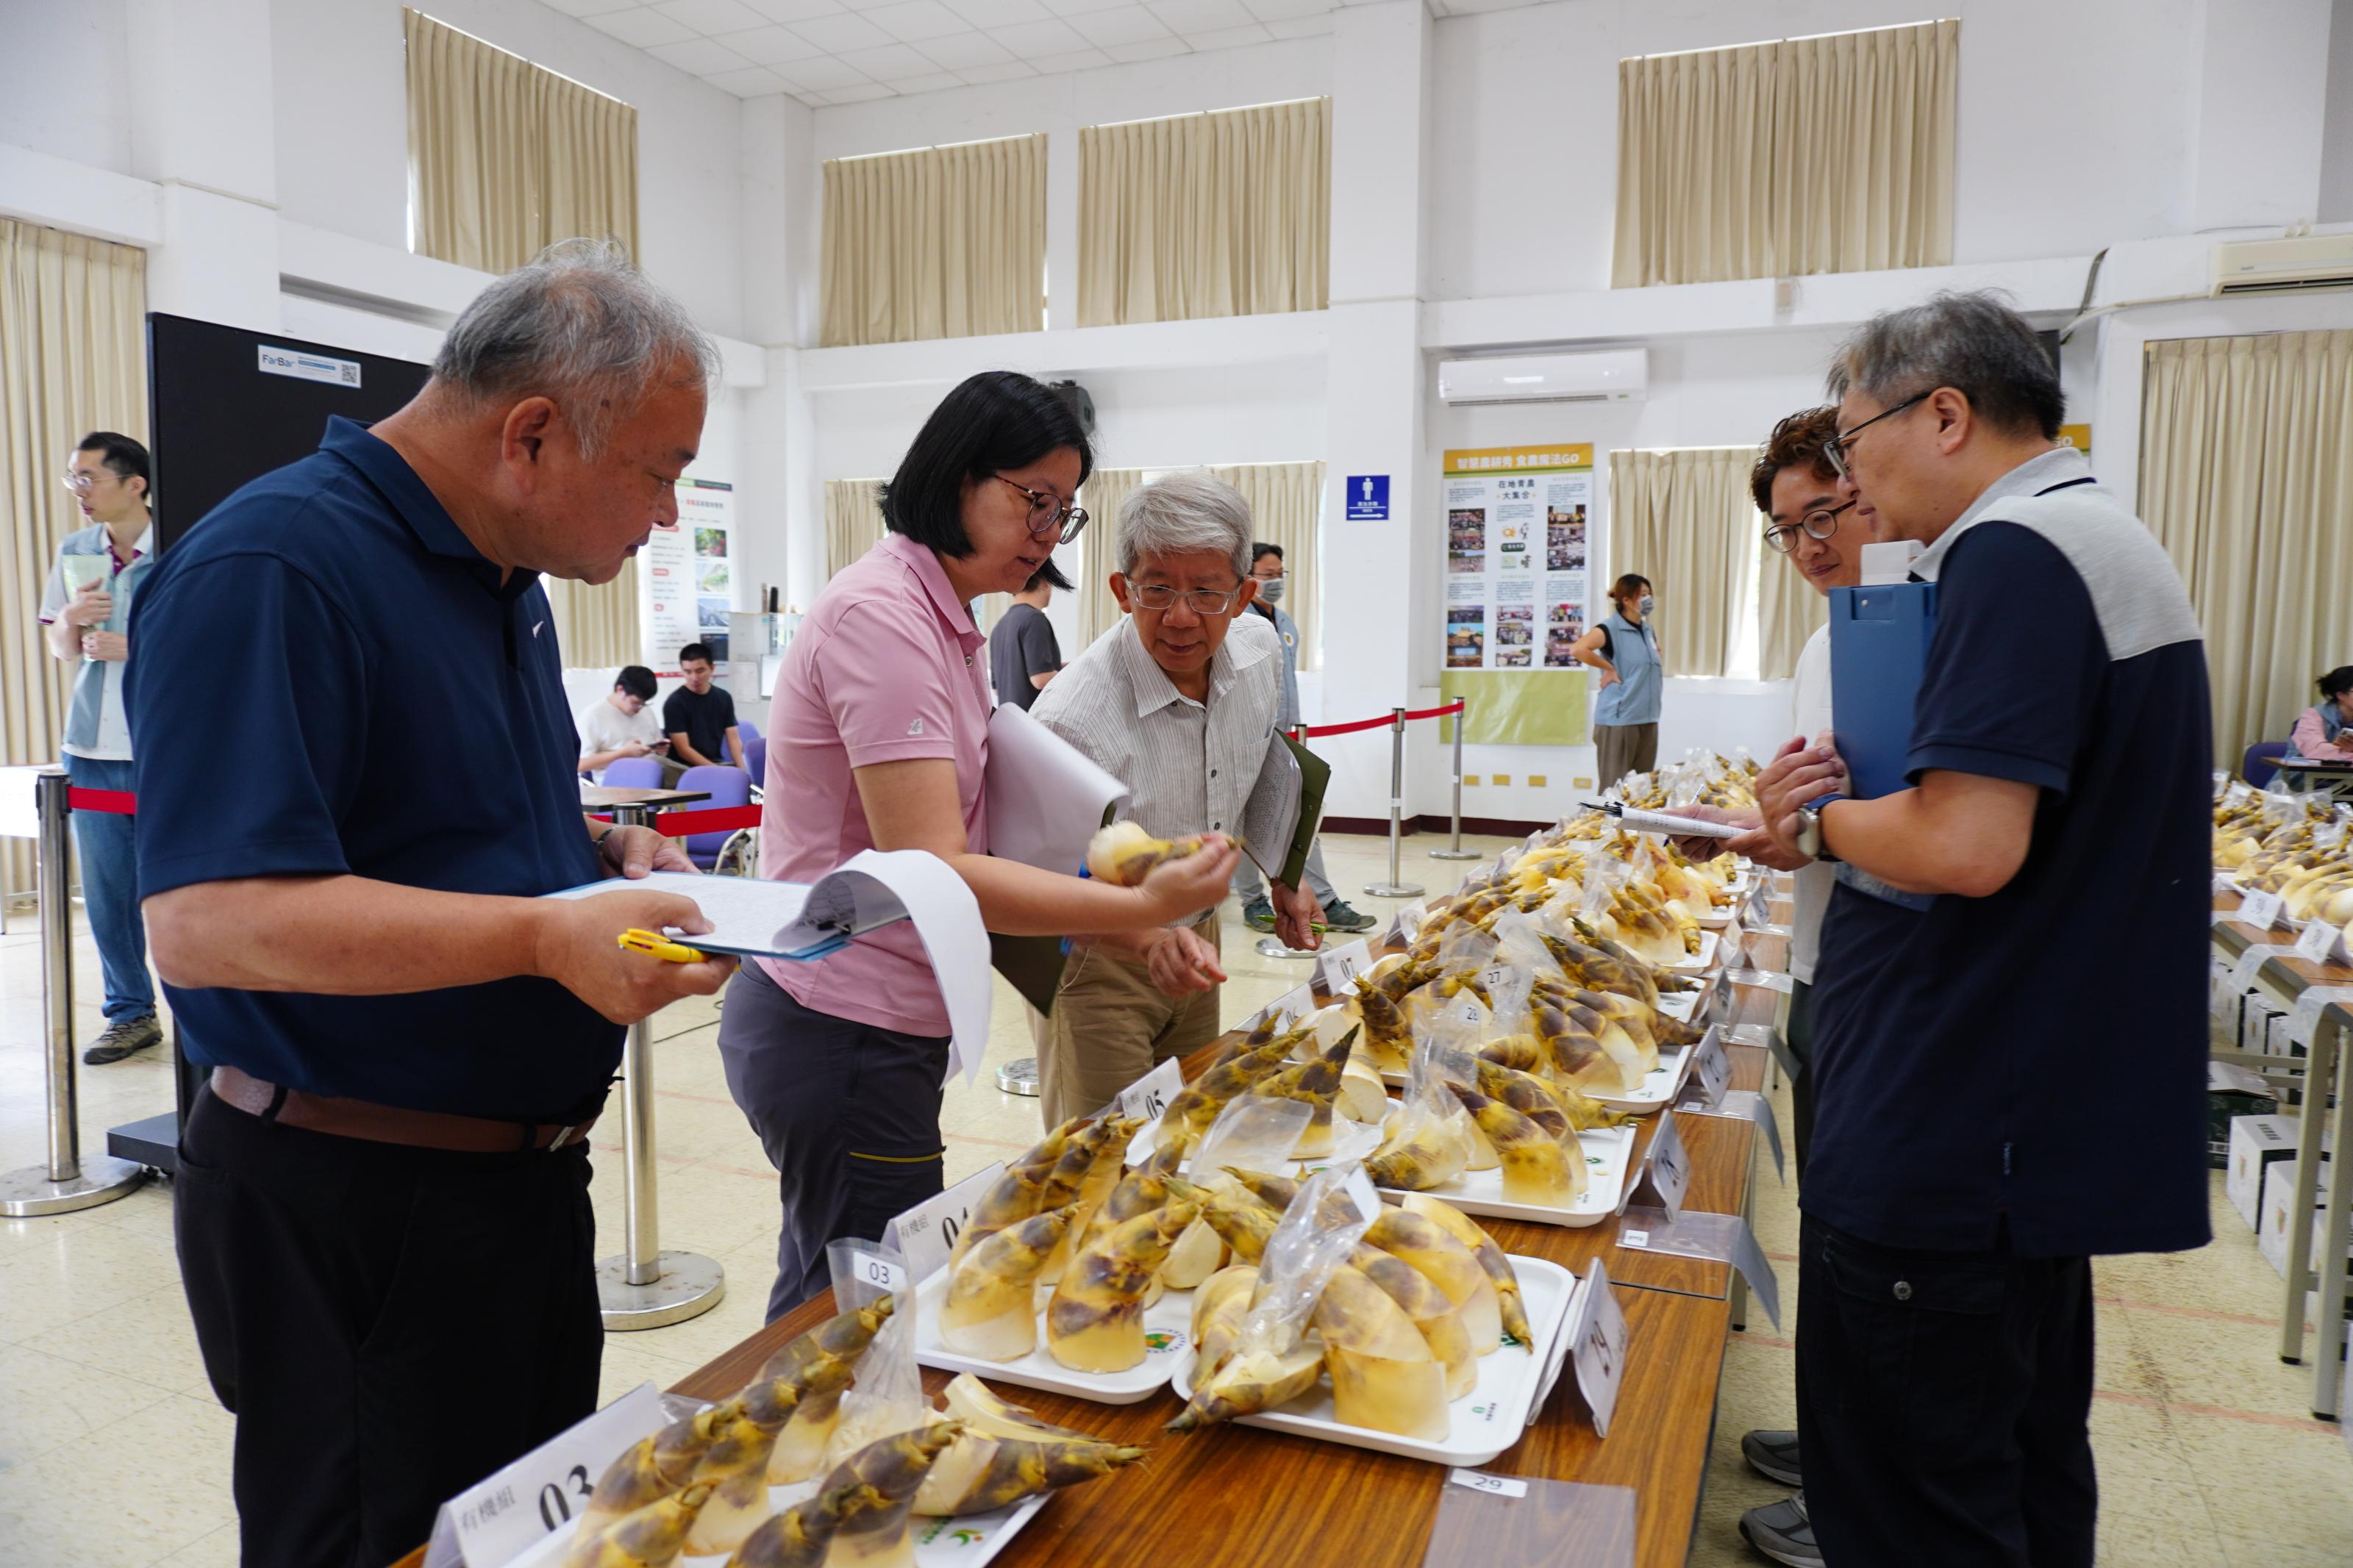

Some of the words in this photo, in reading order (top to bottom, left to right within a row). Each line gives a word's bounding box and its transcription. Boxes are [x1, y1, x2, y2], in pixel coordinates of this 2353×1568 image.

[262, 354, 296, 368] FarBar
[1498, 479, 1535, 490] 在地青農
[1502, 491, 1531, 501] 大集合
[1488, 971, 1500, 984] 27
[1466, 1007, 1479, 1021] 28
[869, 1262, 890, 1284] 03
[1474, 1476, 1502, 1490] 29
